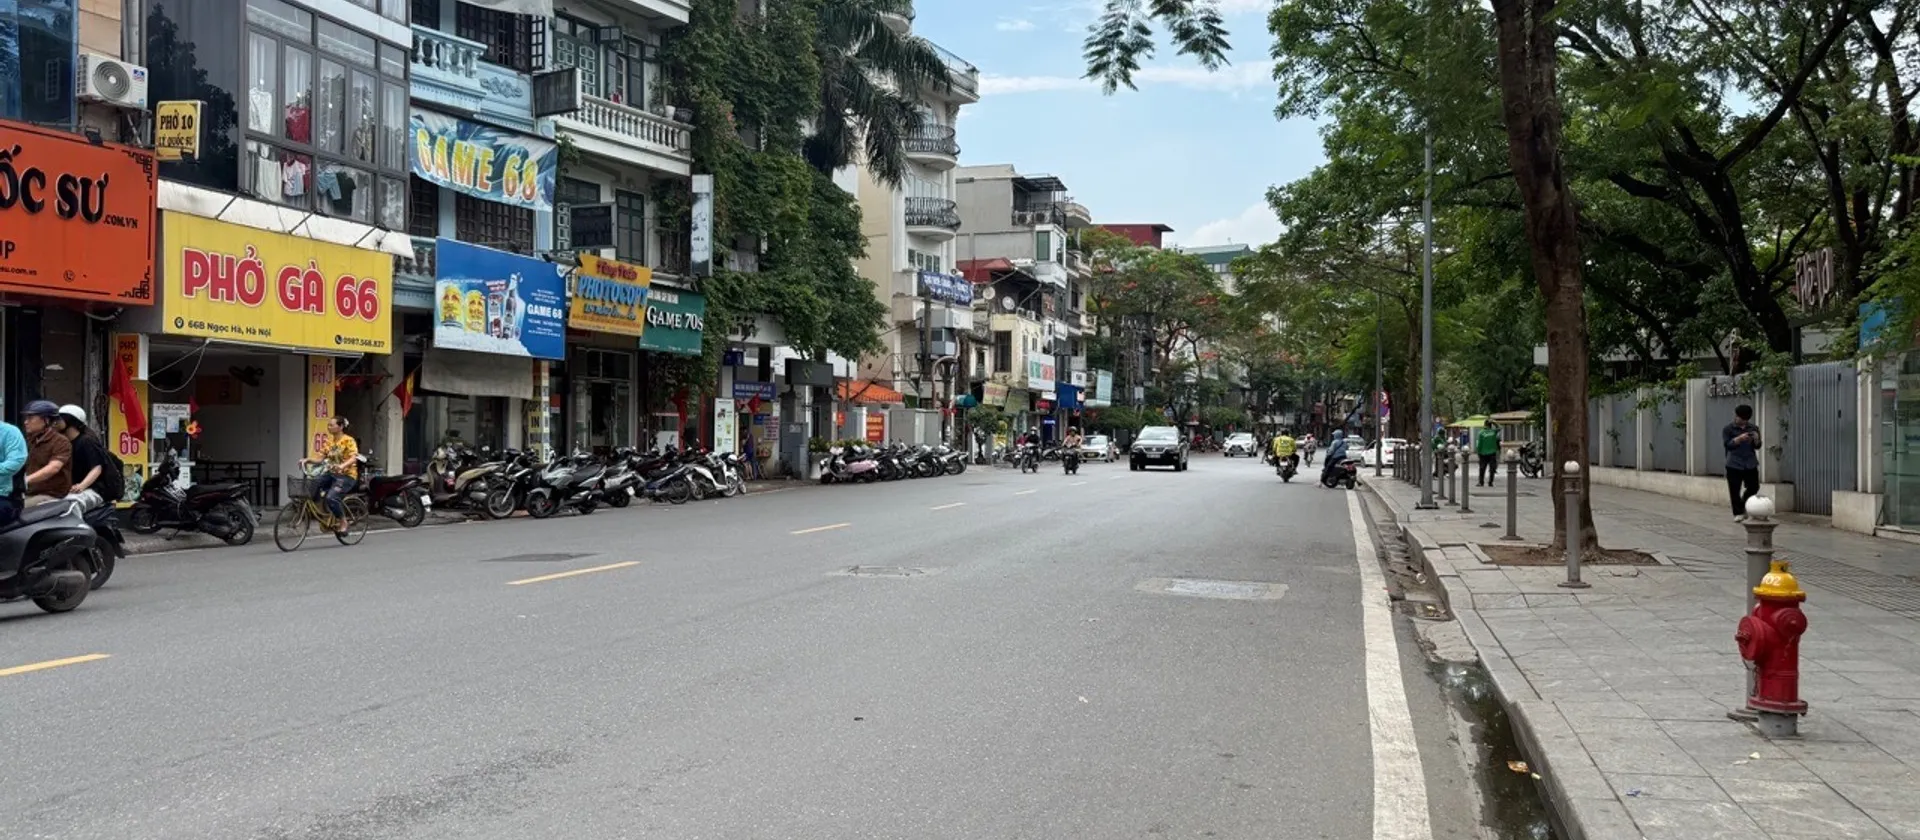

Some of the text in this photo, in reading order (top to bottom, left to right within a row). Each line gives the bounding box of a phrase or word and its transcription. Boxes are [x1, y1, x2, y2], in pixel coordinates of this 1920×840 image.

[160, 109, 193, 130] PHỞ 10
[416, 128, 538, 202] GAME 68
[55, 173, 109, 223] SƯ
[0, 240, 15, 259] P
[183, 245, 266, 306] PHỞ
[277, 260, 325, 314] GÀ
[335, 275, 379, 321] 66
[577, 276, 649, 308] PHOTOCOPY
[527, 304, 563, 319] GAME 68
